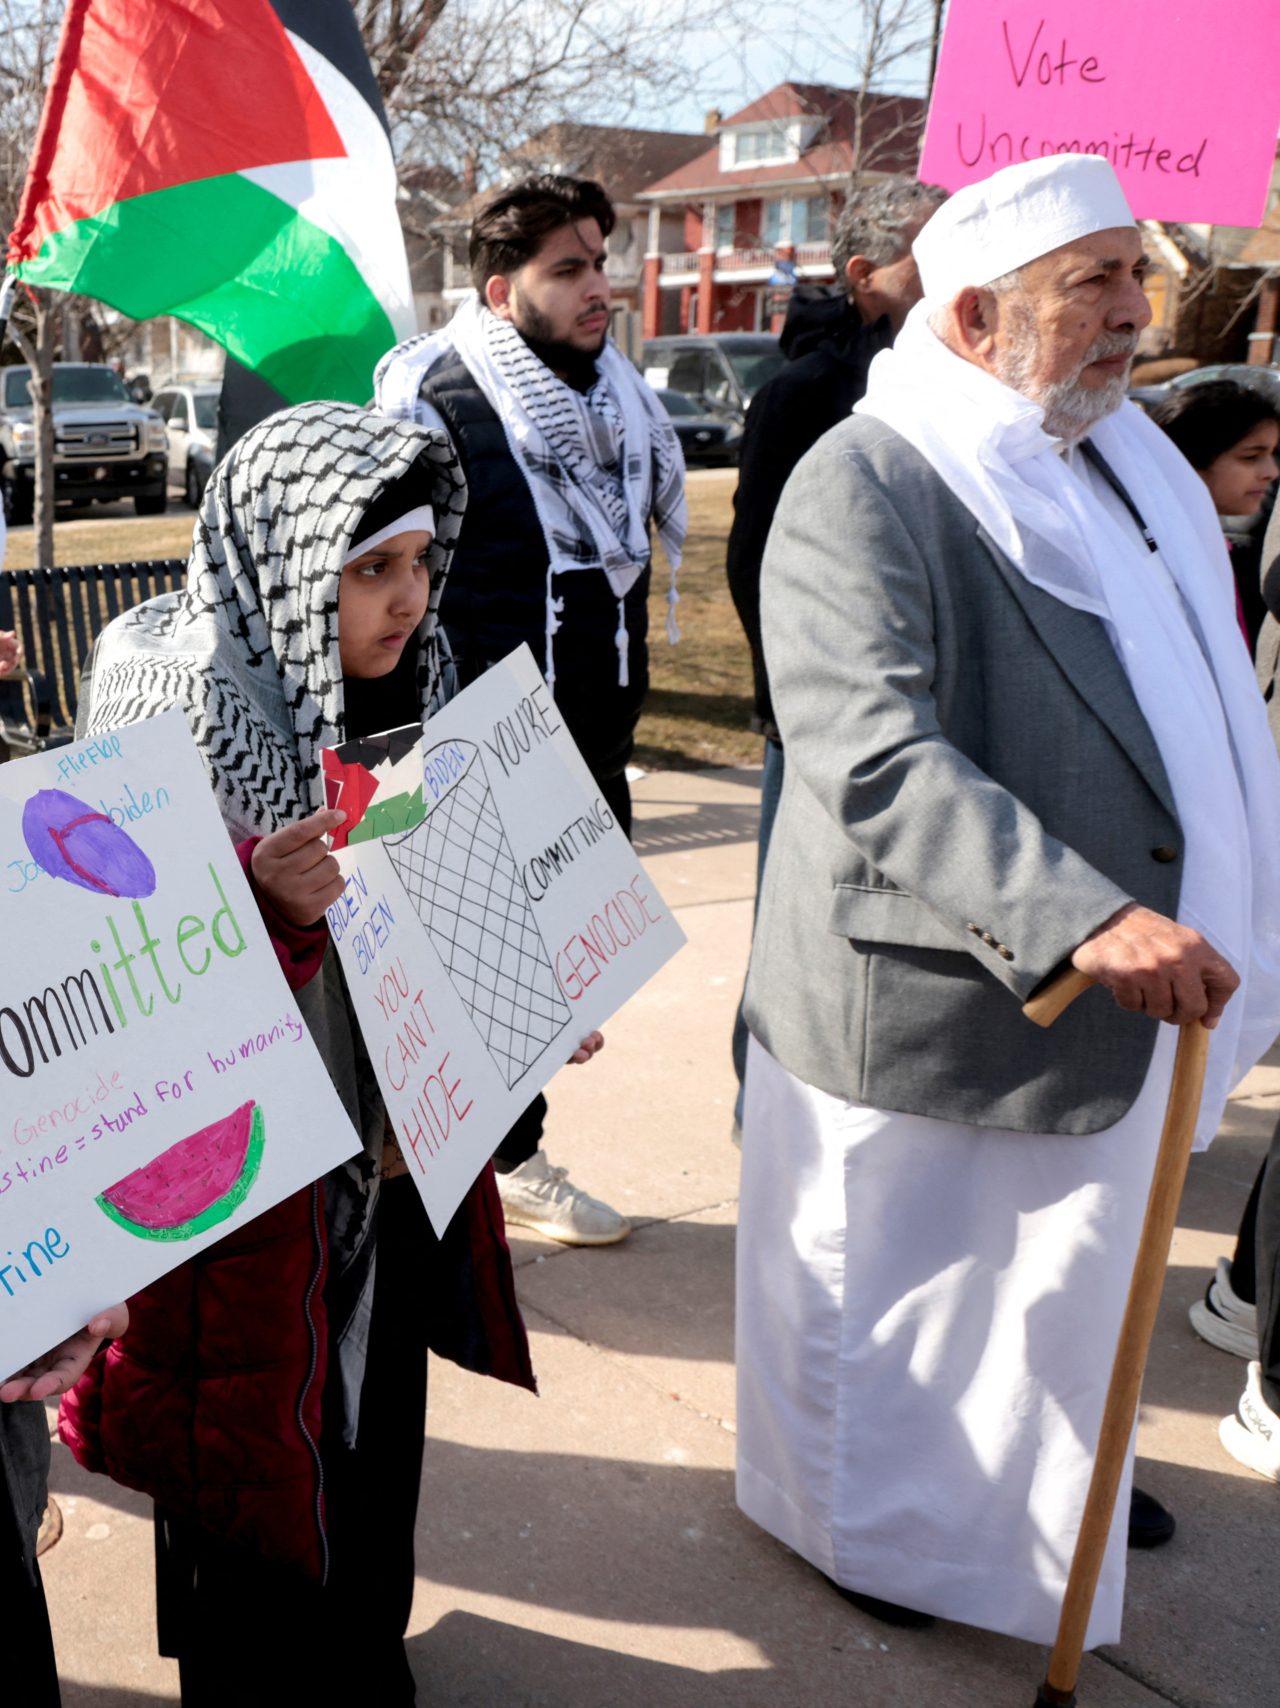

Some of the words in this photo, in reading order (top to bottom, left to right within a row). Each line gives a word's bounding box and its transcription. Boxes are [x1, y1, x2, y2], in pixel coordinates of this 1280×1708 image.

[1001, 18, 1107, 89] Vote
[99, 783, 170, 828] biden
[424, 741, 466, 800] BIDEN
[522, 798, 615, 902] COMMITTING
[326, 866, 369, 942] BIDEN
[351, 893, 396, 976] BIDEN
[554, 873, 662, 1001] GENOCIDE
[373, 956, 410, 1022] YOU
[206, 1012, 305, 1075] humanity
[384, 988, 436, 1092] CANT
[401, 1050, 475, 1175] HIDE
